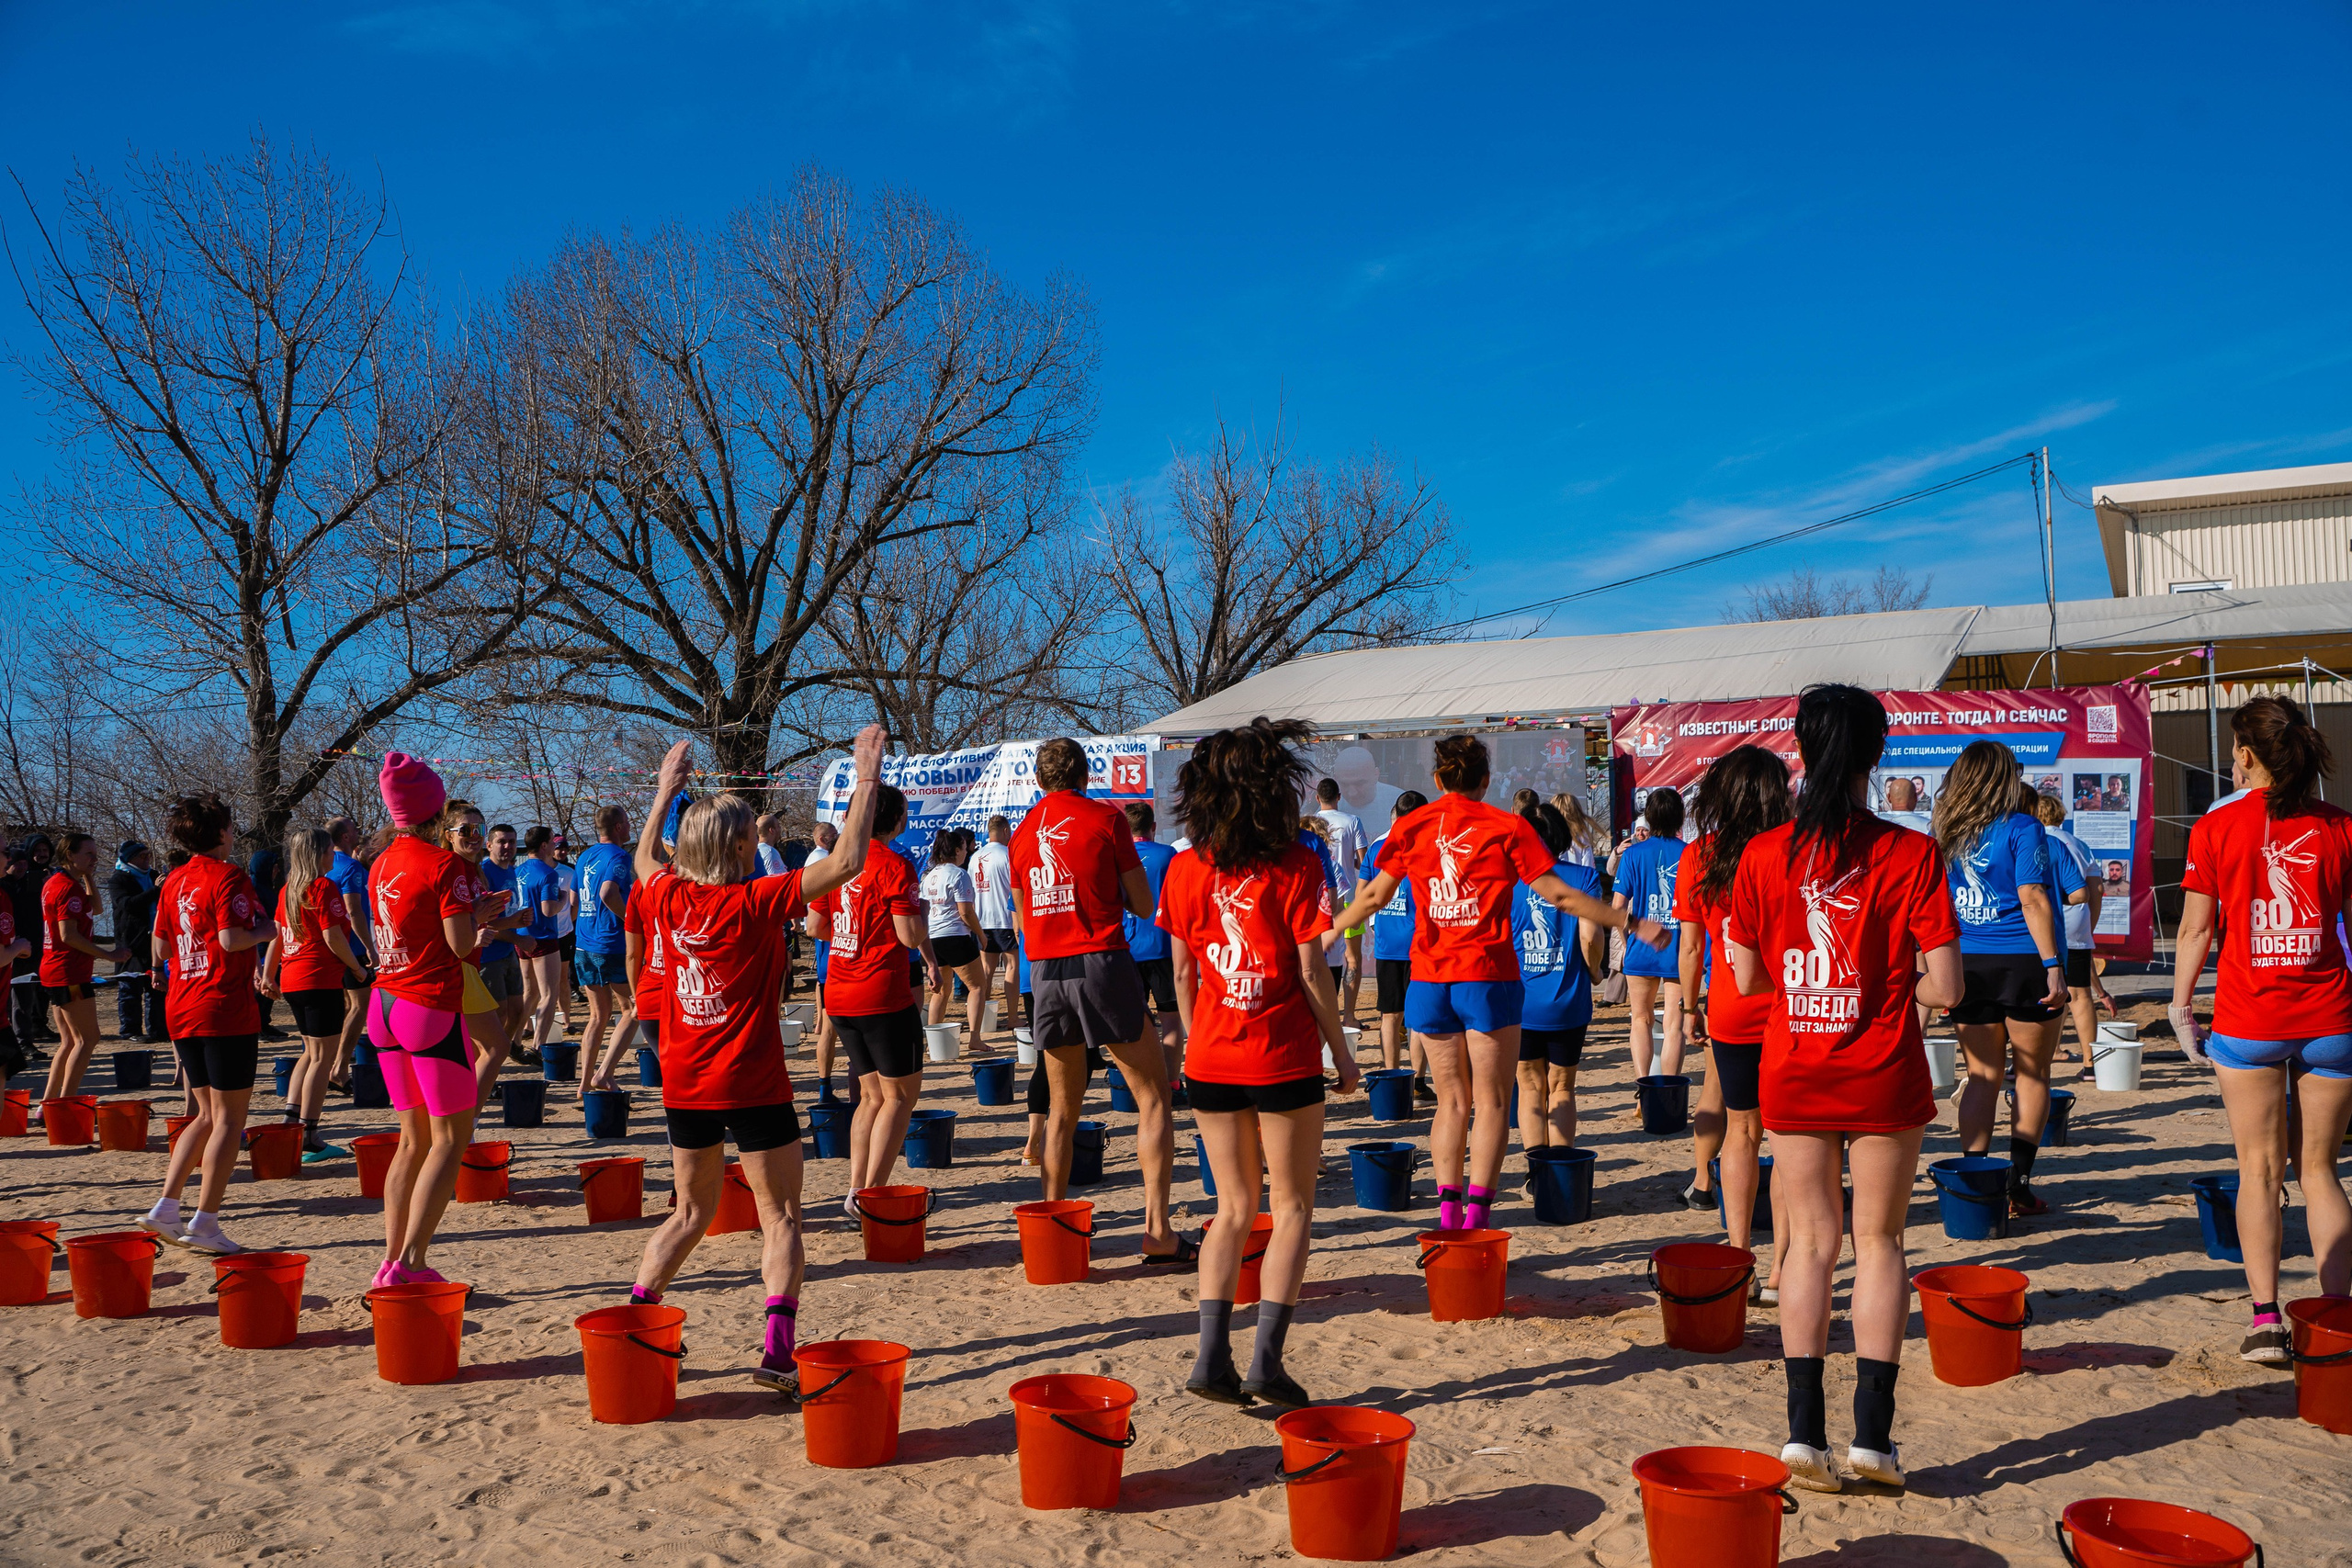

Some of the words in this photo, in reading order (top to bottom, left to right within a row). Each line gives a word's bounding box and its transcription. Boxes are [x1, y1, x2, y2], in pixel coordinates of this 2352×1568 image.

[1679, 719, 1758, 737] ИЗВЕСТНЫЕ
[1947, 710, 1992, 726] ТОГДА
[1995, 709, 2006, 723] И
[2009, 706, 2067, 723] СЕЙЧАС
[1106, 742, 1147, 754] АКЦИЯ
[1904, 745, 1962, 755] СПЕЦИАЛЬНОЙ
[2011, 745, 2049, 753] ПЕРАЦИИ
[1117, 764, 1141, 784] 13
[919, 786, 958, 795] ПОБЕДЫ
[1029, 867, 1055, 891] 80
[1032, 889, 1075, 908] ПОБЕДА
[1429, 877, 1458, 903] 80
[1954, 886, 1984, 908] 80
[1032, 908, 1047, 918] БУДЕТ
[1047, 907, 1057, 915] ЗА
[1429, 903, 1481, 919] ПОБЕДА
[1648, 894, 1669, 911] 80
[832, 911, 852, 933] 80
[2250, 898, 2294, 931] 80
[176, 933, 191, 955] 80
[374, 924, 394, 950] 80
[1522, 930, 1548, 950] 80
[2250, 935, 2322, 956] ПОБЕДА
[1524, 951, 1564, 965] ПОБЕДА
[2251, 956, 2280, 967] БУДЕТ
[2280, 956, 2293, 966] ЗА
[1783, 948, 1831, 989] 80
[676, 964, 705, 997] 80
[695, 1018, 705, 1027] ЗА
[1813, 1021, 1825, 1033] ЗА
